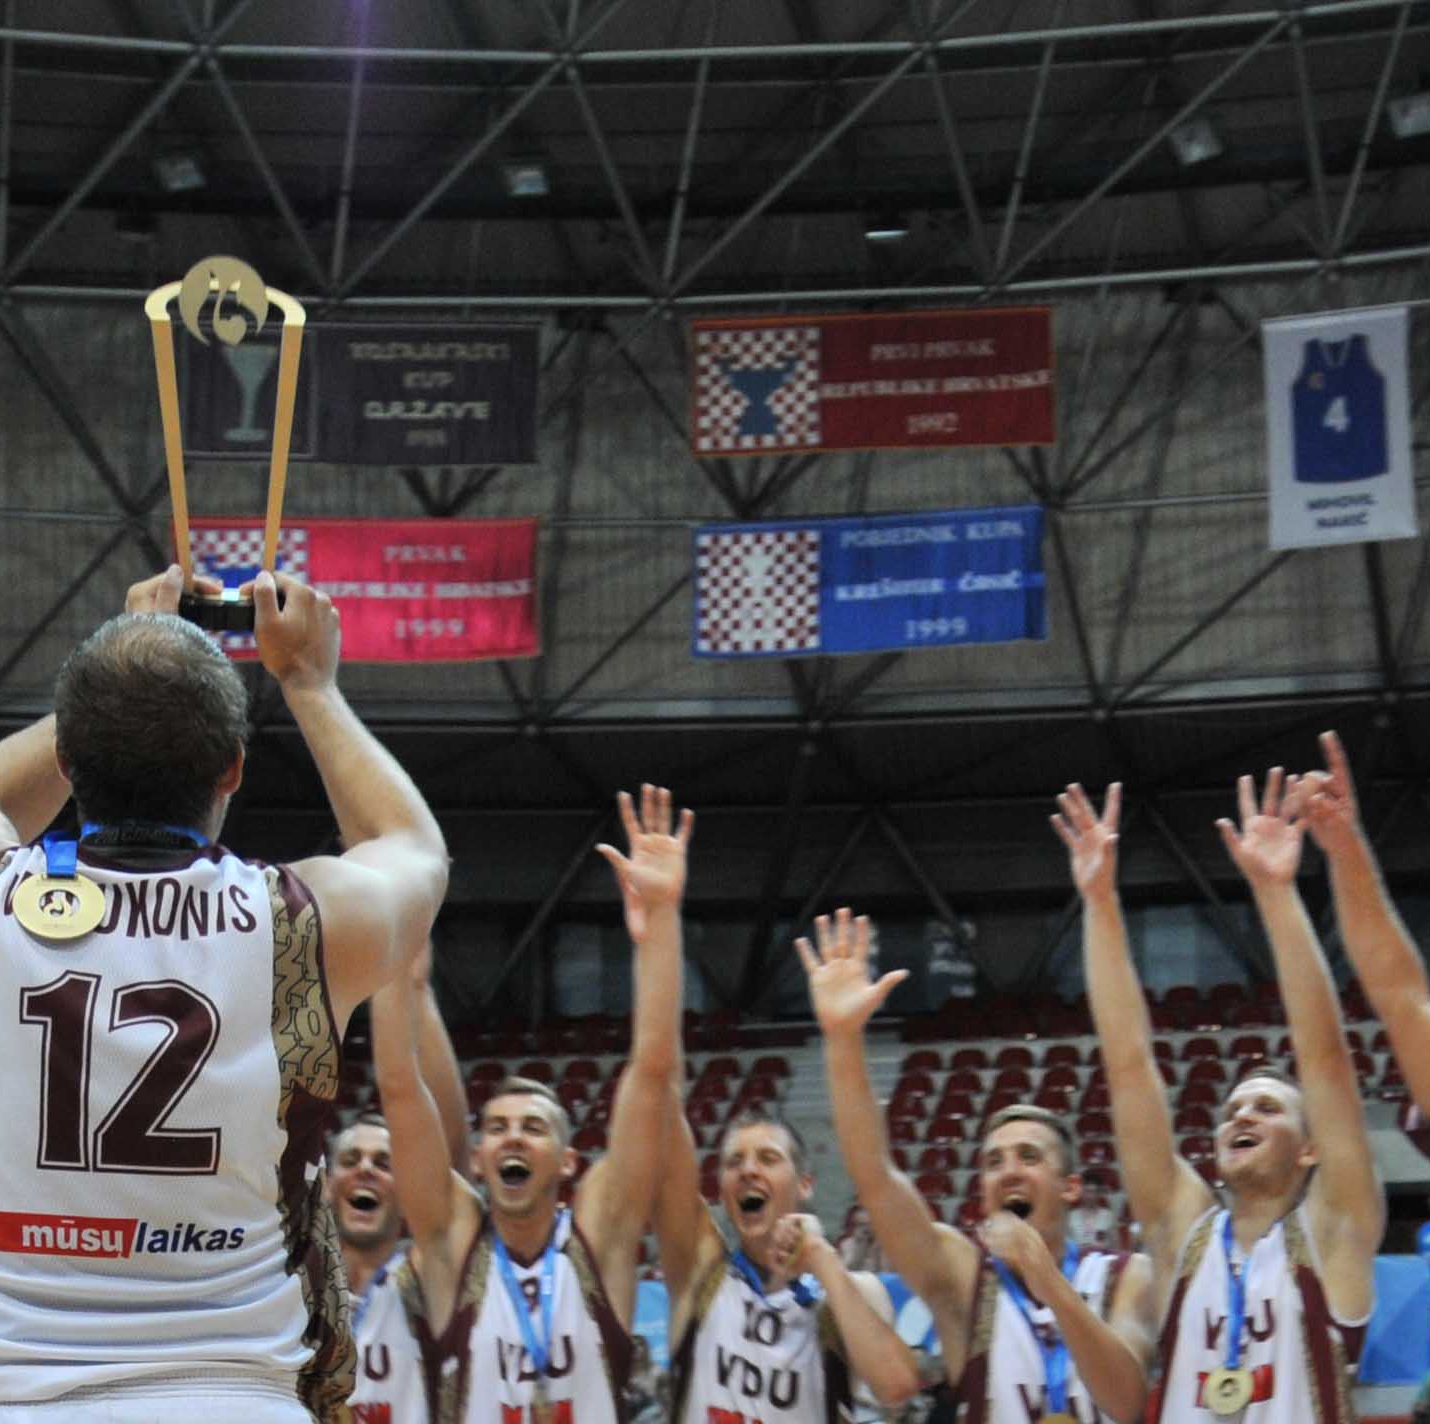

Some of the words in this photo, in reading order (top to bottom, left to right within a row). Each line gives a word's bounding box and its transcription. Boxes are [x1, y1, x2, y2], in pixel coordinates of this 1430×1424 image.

[1323, 395, 1352, 433] 4
[383, 545, 465, 564] PRVAK
[394, 616, 465, 641] 1999
[906, 616, 968, 641] 1999
[19, 969, 222, 1176] 12
[22, 1219, 124, 1260] mūsų
[134, 1221, 246, 1254] laikas
[718, 1345, 799, 1410] VDU
